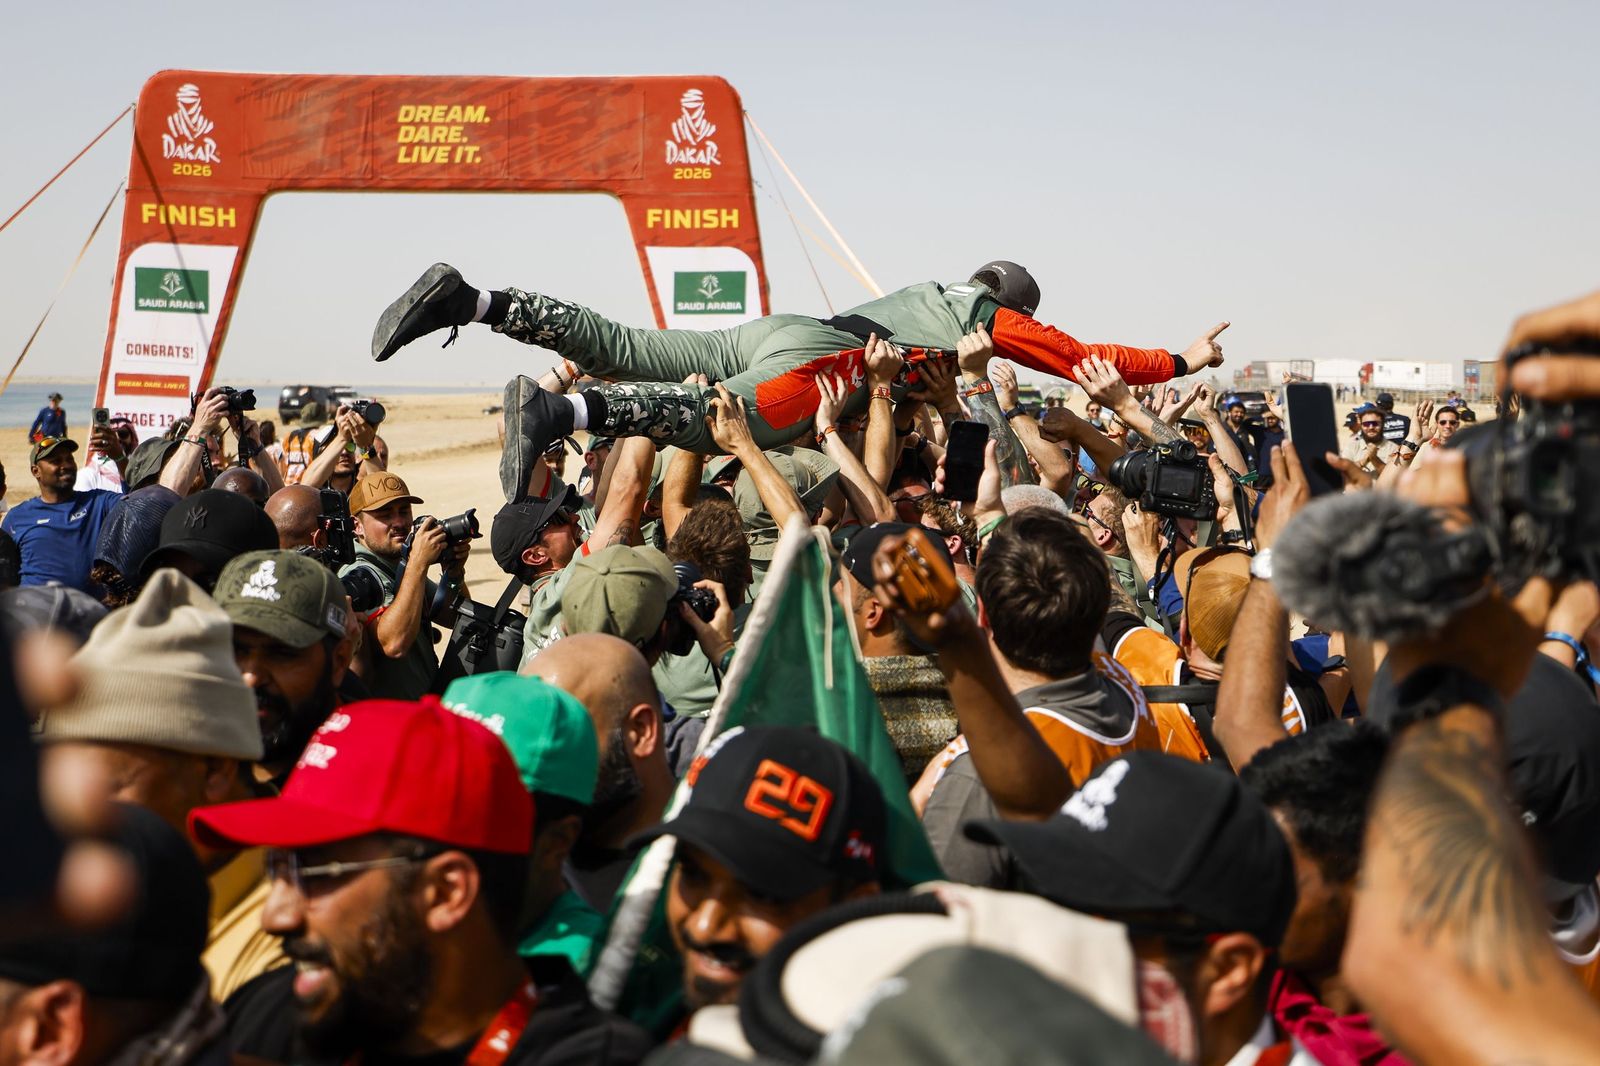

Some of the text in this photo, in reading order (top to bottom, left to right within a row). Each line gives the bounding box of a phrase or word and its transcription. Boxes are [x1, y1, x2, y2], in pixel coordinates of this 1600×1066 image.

[397, 105, 491, 123] DREAM.
[397, 125, 469, 143] DARE.
[397, 145, 482, 163] LIVE IT.
[172, 162, 212, 177] 2026
[673, 167, 712, 180] 2026
[141, 203, 236, 228] FINISH
[646, 208, 739, 229] FINISH
[138, 298, 206, 310] SAUDI ARABIA
[677, 301, 742, 311] SAUDI ARABIA
[126, 343, 194, 359] CONGRATS!
[743, 758, 835, 843] 29
